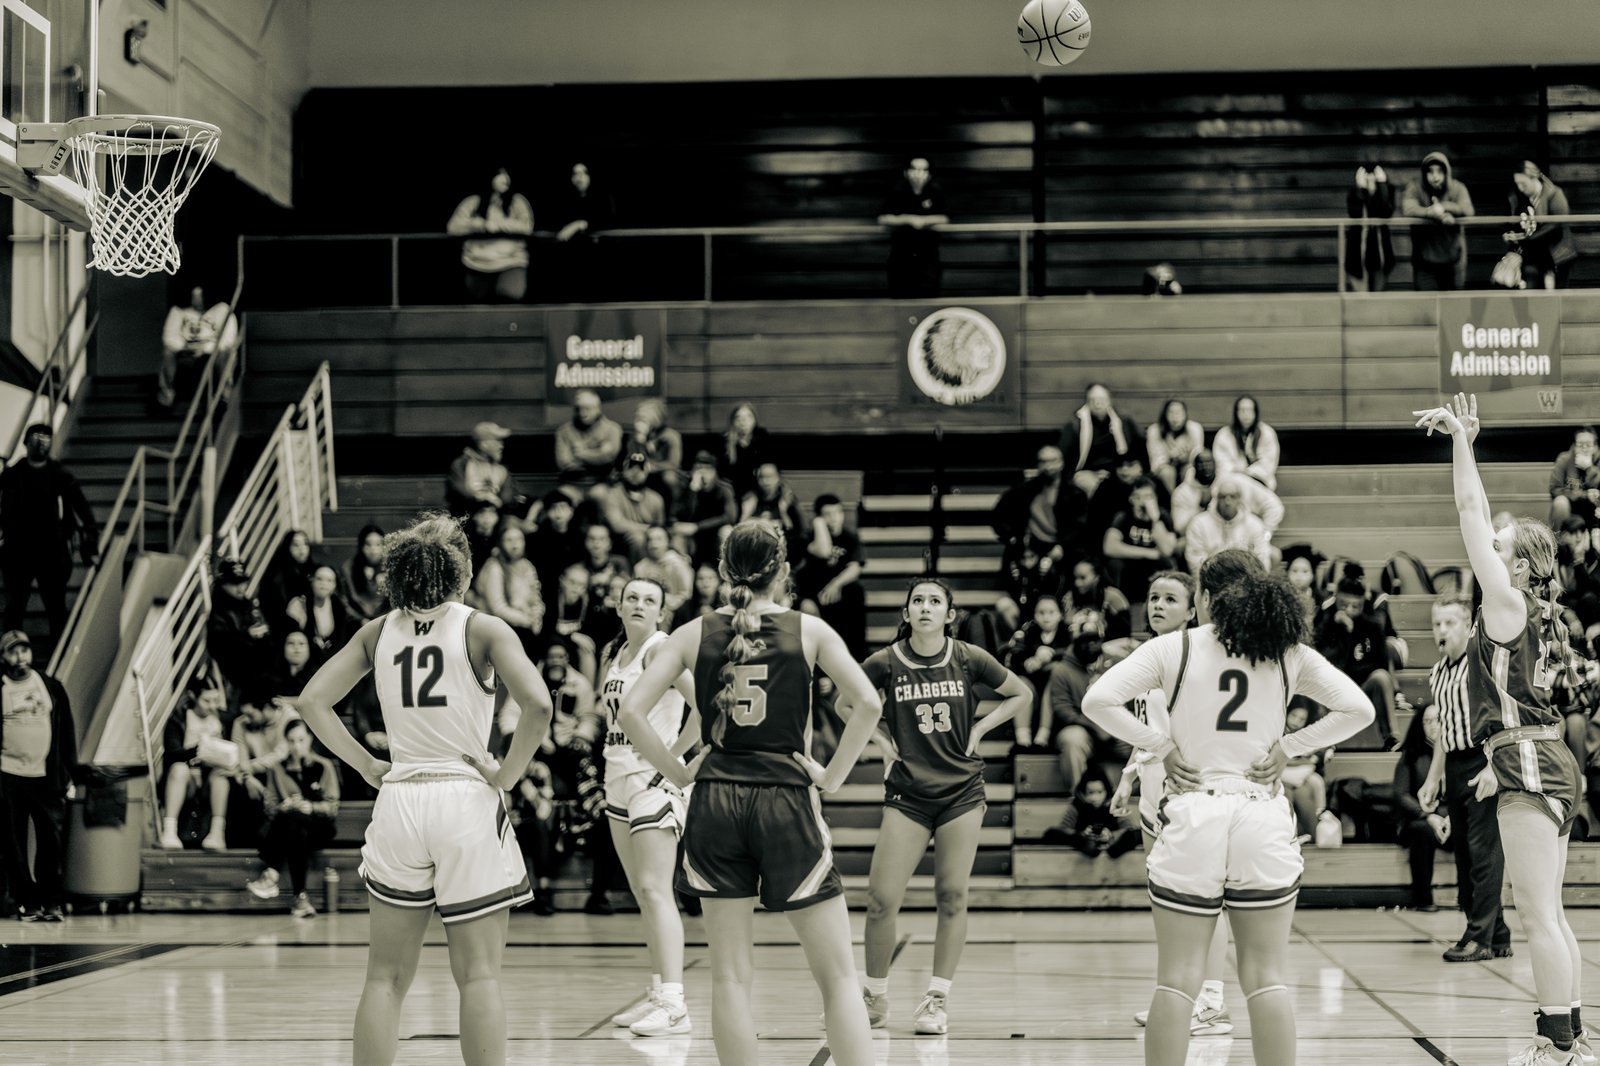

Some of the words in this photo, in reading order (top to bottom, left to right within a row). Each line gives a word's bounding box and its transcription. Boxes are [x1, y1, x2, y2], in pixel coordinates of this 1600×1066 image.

[566, 334, 644, 361] General
[1461, 322, 1540, 349] General
[554, 362, 655, 388] Admission
[1450, 350, 1551, 377] Admission
[1538, 391, 1560, 413] W
[393, 645, 448, 708] 12
[732, 664, 768, 727] 5
[894, 680, 965, 703] CHARGERS
[1216, 669, 1249, 732] 2
[915, 702, 952, 735] 33
